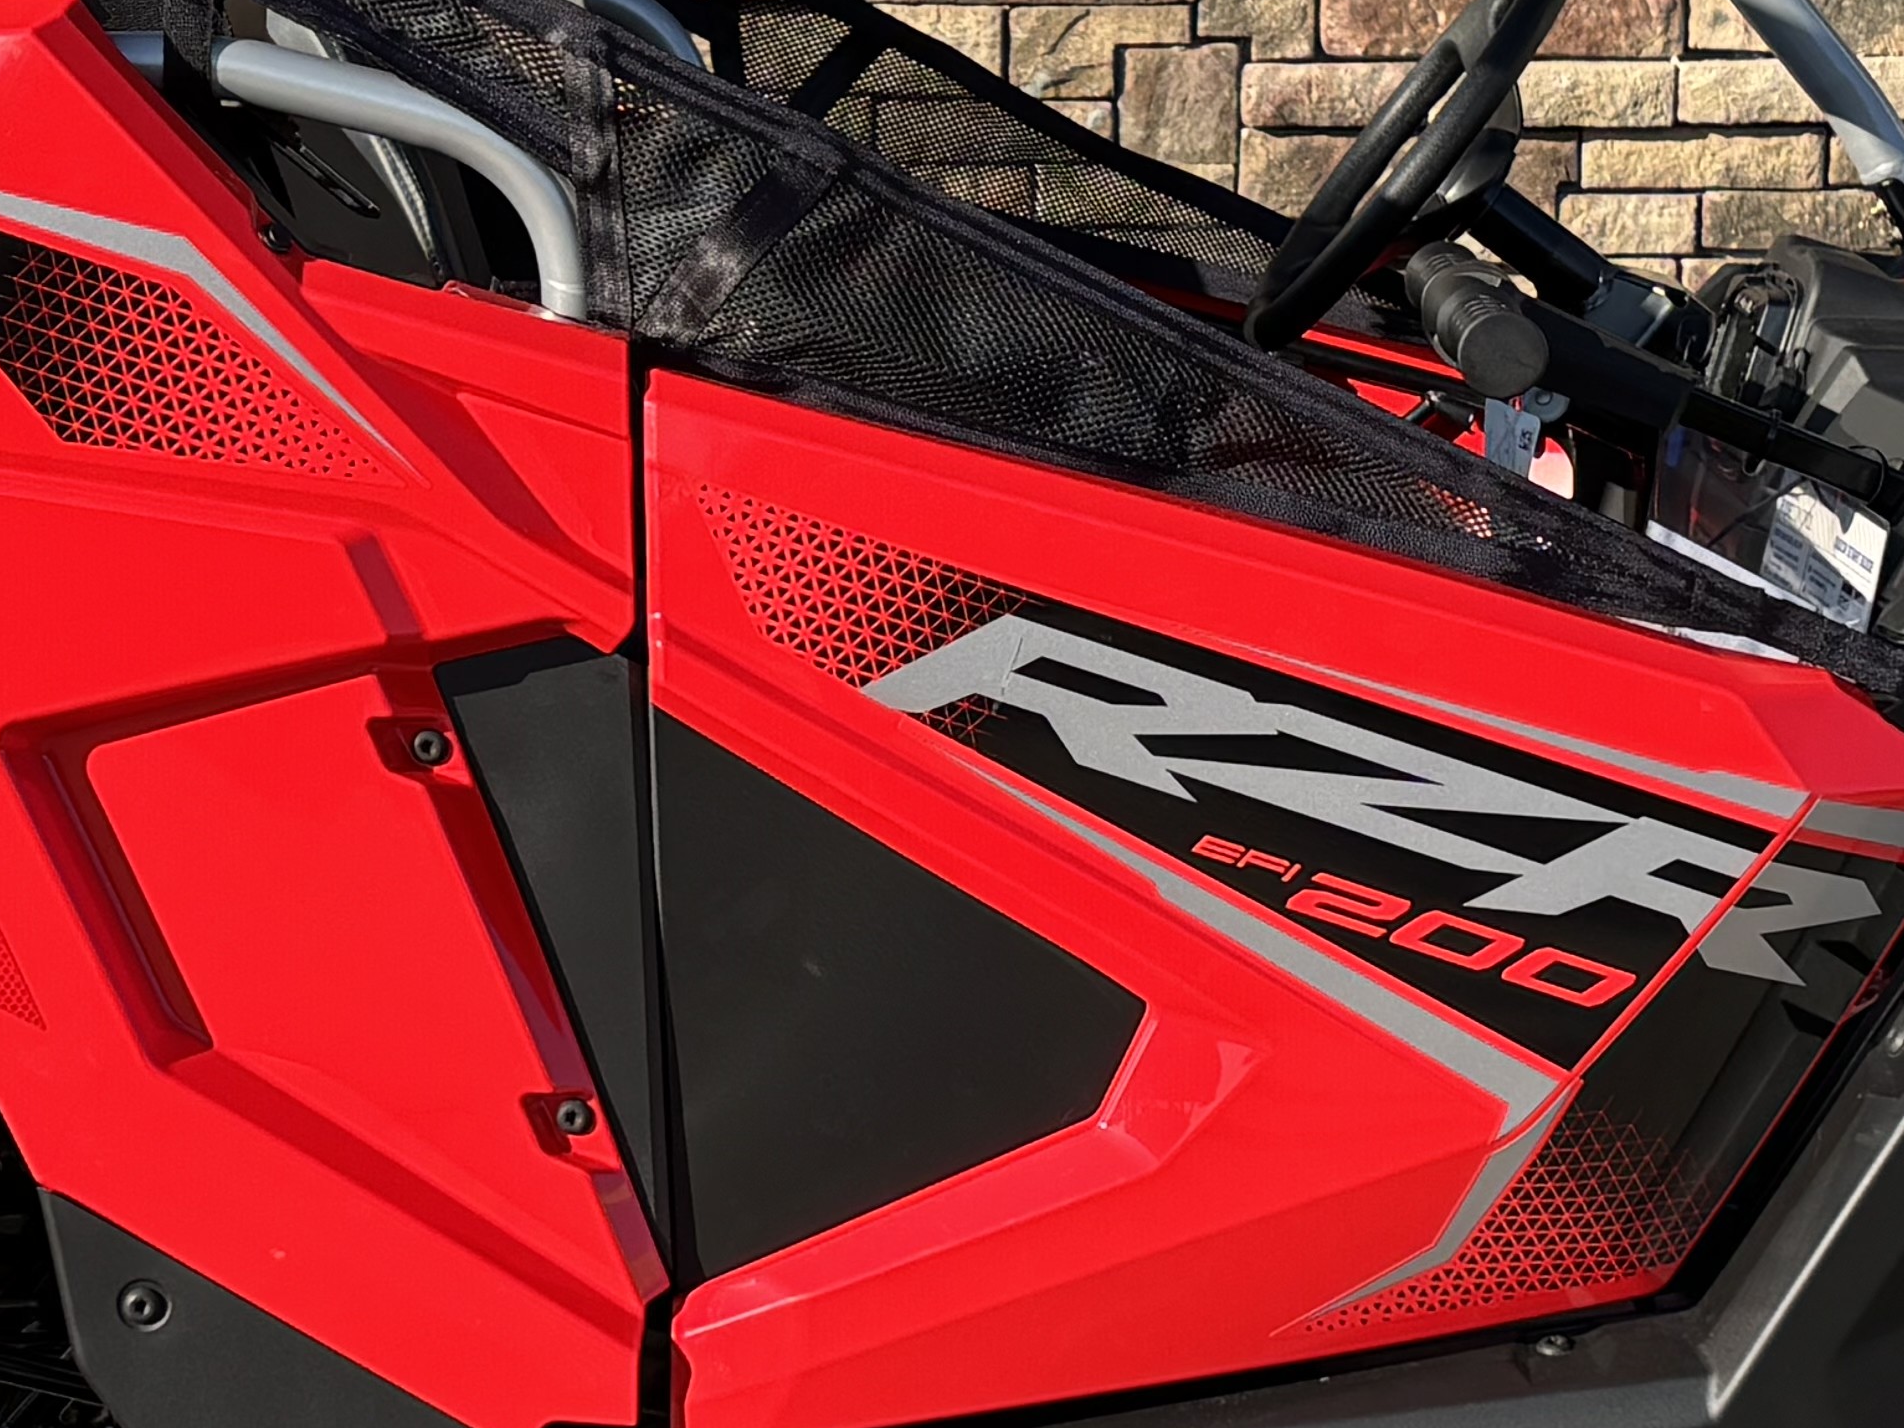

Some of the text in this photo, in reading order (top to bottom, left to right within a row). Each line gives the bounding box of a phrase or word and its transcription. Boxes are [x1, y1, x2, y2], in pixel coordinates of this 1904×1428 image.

[860, 612, 1883, 985] RZR
[1192, 835, 1637, 1008] EFI 200
